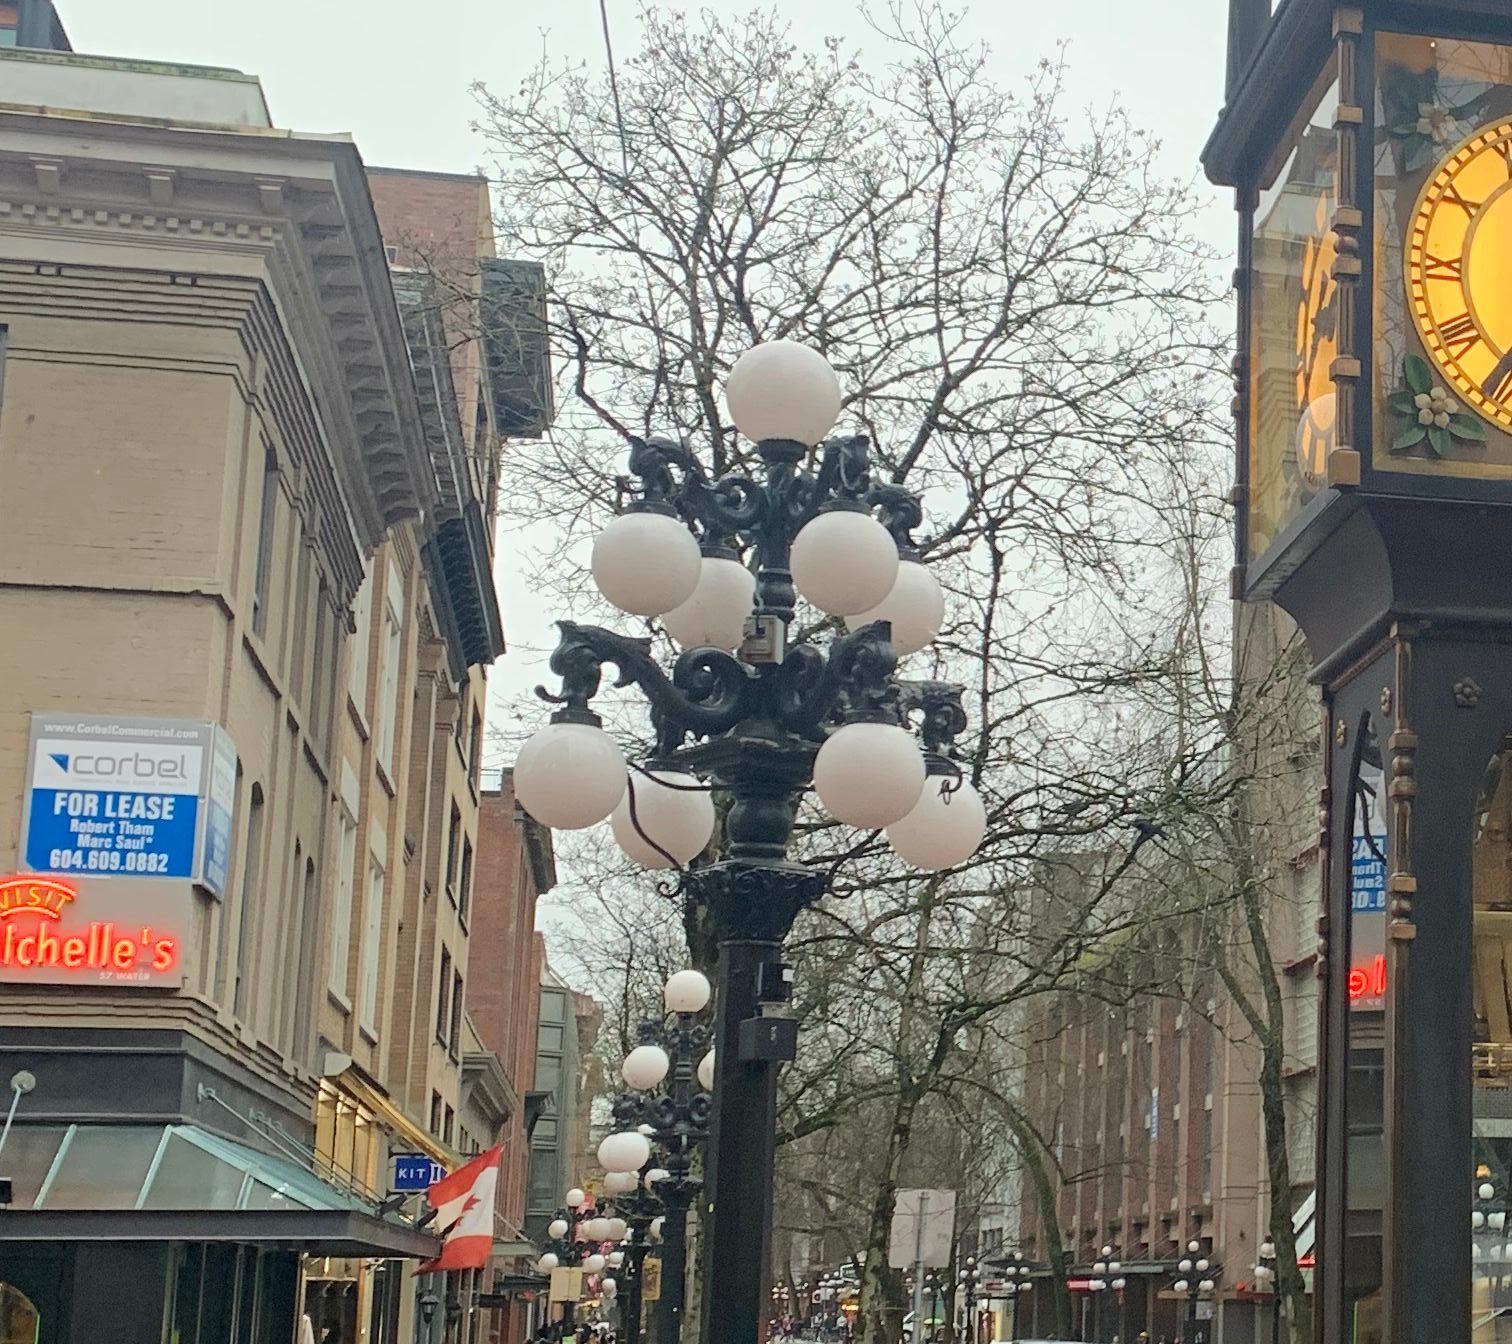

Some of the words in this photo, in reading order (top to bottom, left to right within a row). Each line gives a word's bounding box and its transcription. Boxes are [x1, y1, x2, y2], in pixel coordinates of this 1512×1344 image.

[43, 722, 199, 740] www.CorbelCommercial.com
[72, 752, 188, 780] corbel
[53, 791, 99, 817] FOR
[104, 794, 176, 821] LEASE
[69, 818, 115, 834] Robert
[118, 821, 155, 836] Tham
[76, 834, 113, 849] Marc
[49, 848, 169, 873] 604.609.0882
[398, 1167, 426, 1179] KIT
